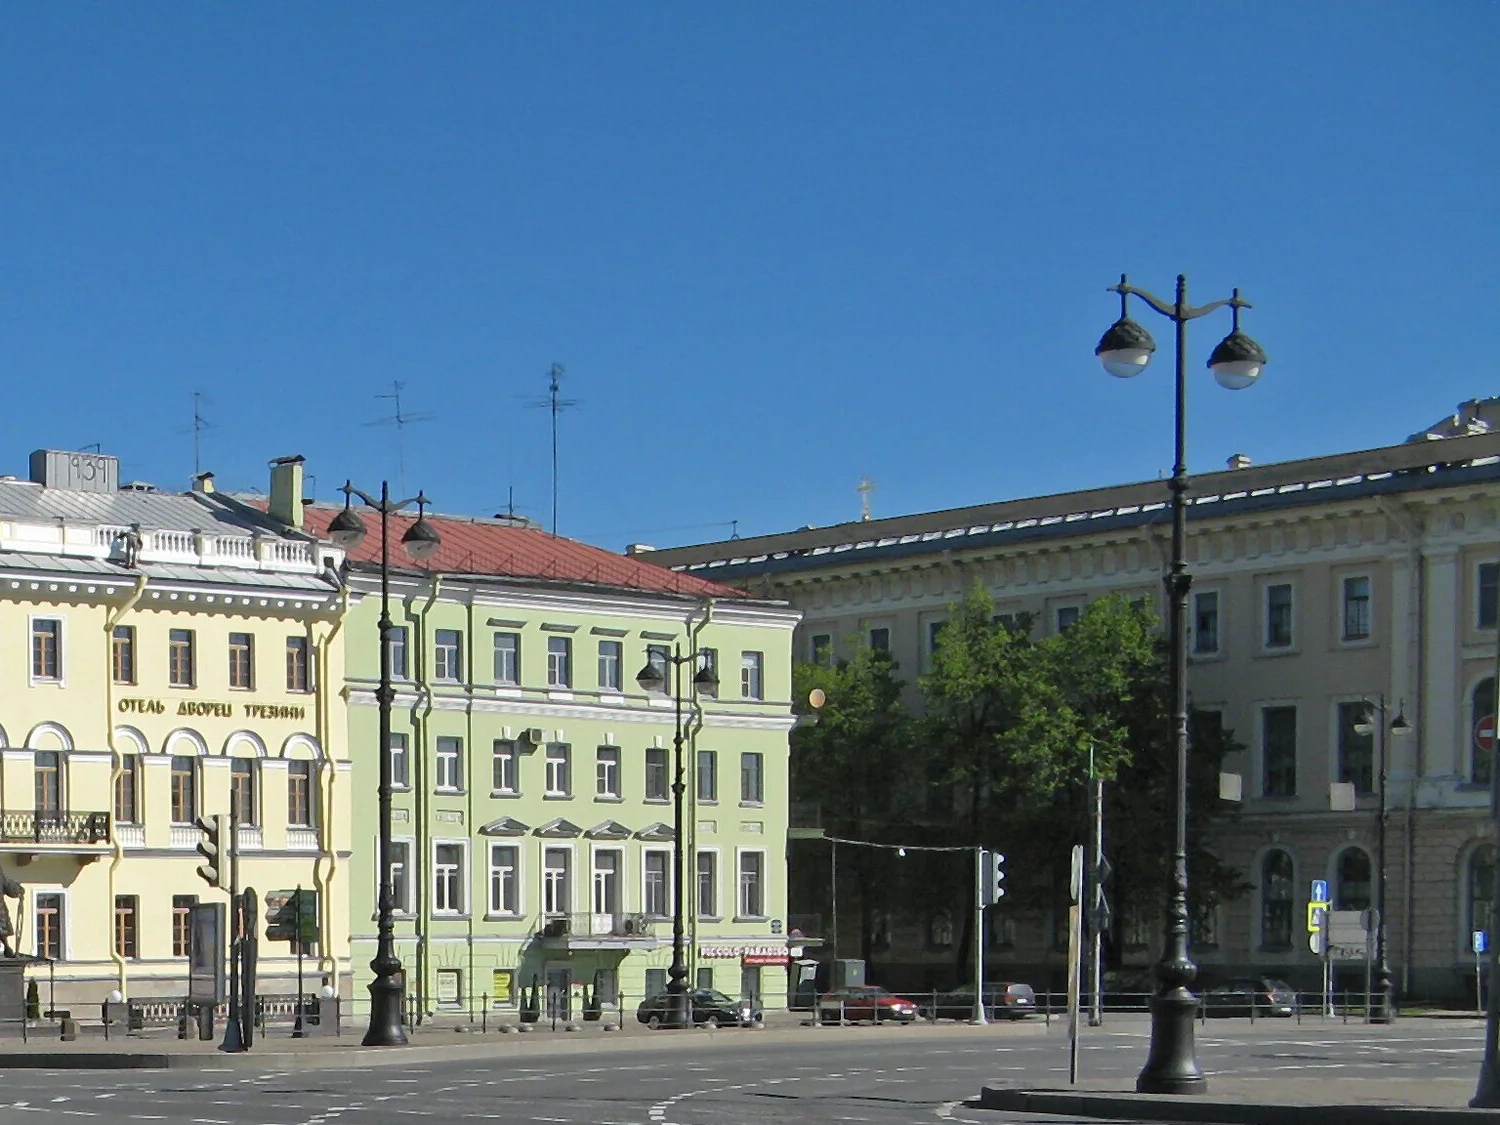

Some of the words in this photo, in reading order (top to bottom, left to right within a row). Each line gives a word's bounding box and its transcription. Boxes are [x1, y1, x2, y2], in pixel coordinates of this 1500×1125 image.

[117, 698, 166, 715] ОТЕЛЬ
[176, 701, 233, 718] ДВОРЕЦ
[242, 704, 306, 721] ТРЕЗИНИ
